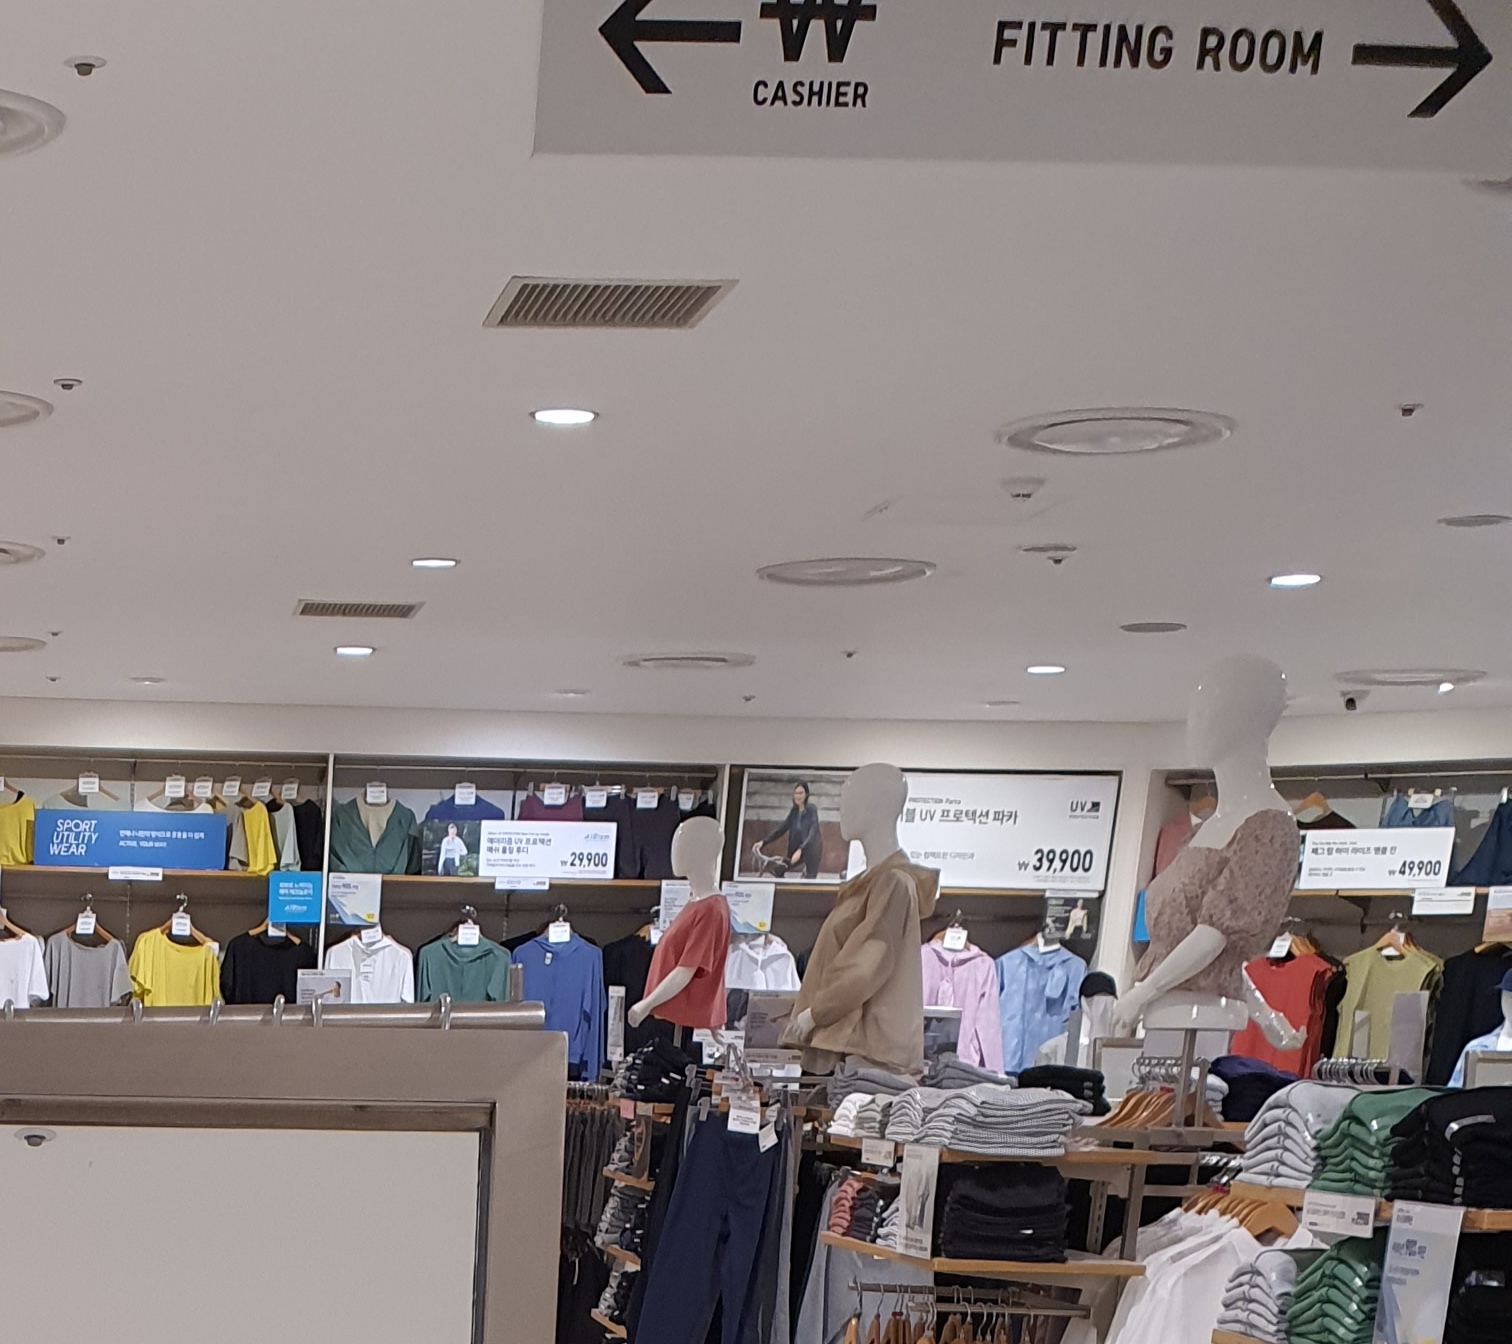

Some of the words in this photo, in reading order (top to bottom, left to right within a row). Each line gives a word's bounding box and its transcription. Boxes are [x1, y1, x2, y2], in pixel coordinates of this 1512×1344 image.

[992, 20, 1175, 71] FITTING
[1198, 28, 1324, 76] ROOM
[752, 80, 869, 110] CASHIER
[1070, 800, 1087, 812] UV
[920, 809, 936, 822] UV
[939, 809, 989, 825] 프로텍션
[992, 809, 1018, 825] 파카
[56, 819, 98, 832] SPORT
[53, 831, 99, 845] UTILITY
[49, 843, 86, 856] WEAR
